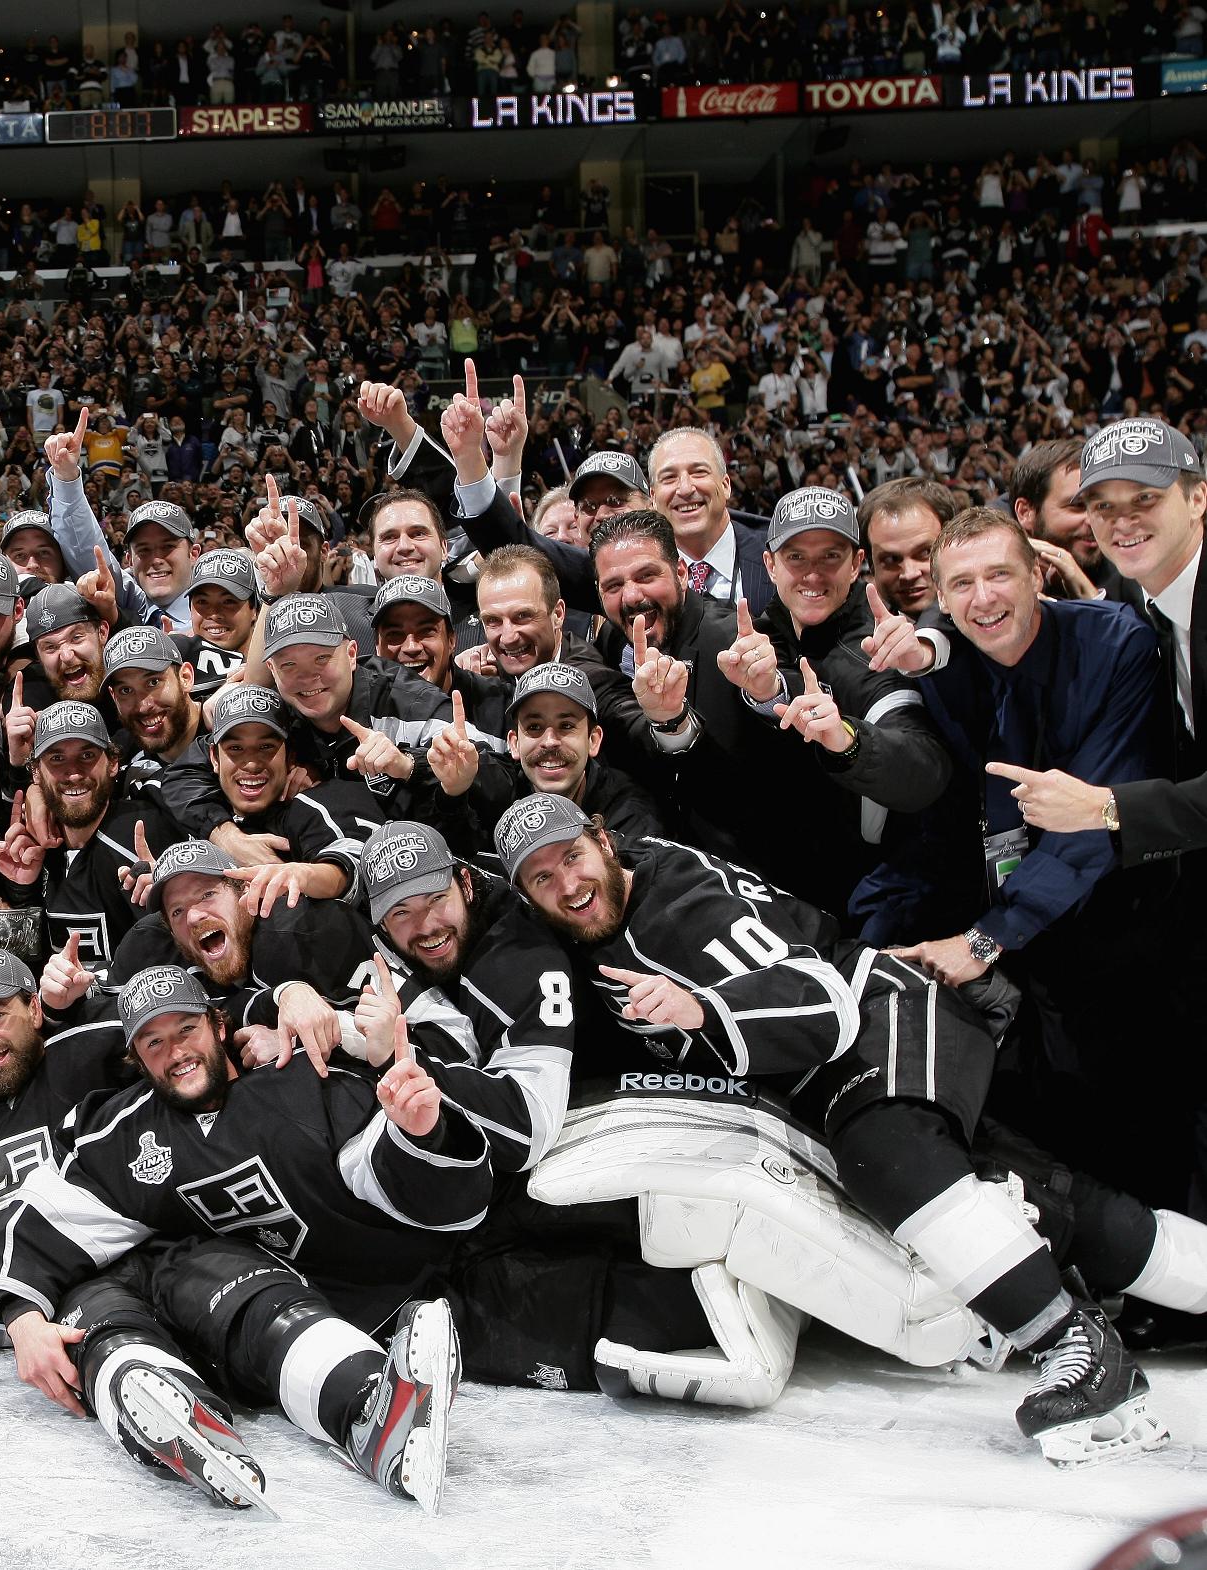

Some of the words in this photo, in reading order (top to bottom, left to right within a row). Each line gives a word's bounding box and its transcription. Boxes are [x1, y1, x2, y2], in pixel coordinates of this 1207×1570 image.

[805, 78, 939, 109] TOYOTA
[963, 73, 1012, 107] LA
[1024, 66, 1135, 103] KINGS
[191, 105, 302, 134] STAPLES
[324, 102, 362, 119] SAN
[372, 99, 444, 117] MANUEL
[325, 119, 360, 129] INDIAN
[471, 96, 518, 128] LA
[532, 90, 636, 125] KINGS
[702, 915, 789, 976] 10
[538, 970, 575, 1028] 8
[619, 1072, 749, 1097] Reebok
[135, 1149, 172, 1174] FINAL
[187, 1172, 278, 1222] LA
